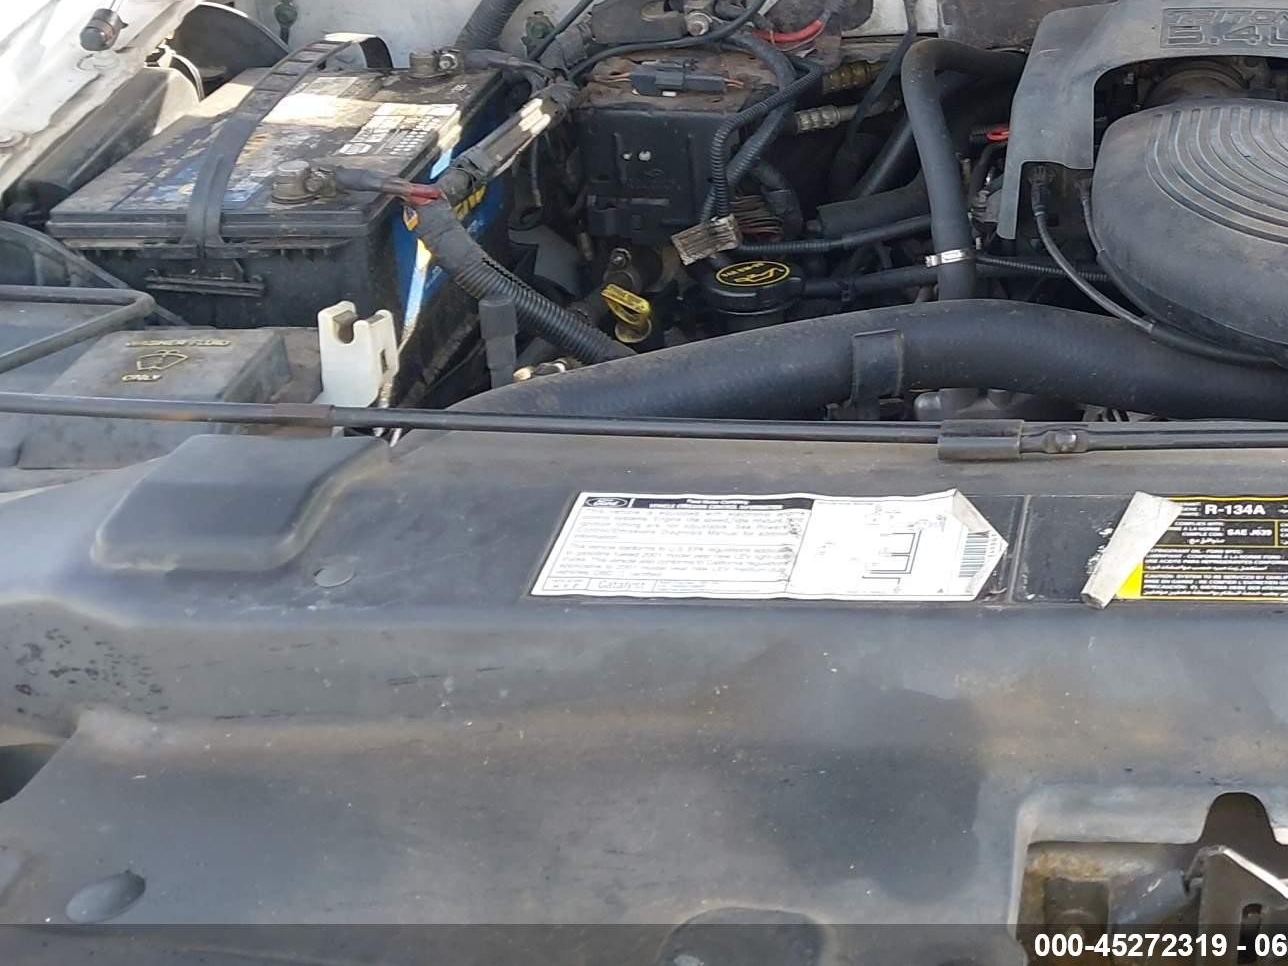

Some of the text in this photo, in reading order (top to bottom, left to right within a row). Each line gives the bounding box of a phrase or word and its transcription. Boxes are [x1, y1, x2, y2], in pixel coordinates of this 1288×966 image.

[189, 338, 232, 346] FLUID
[1205, 504, 1266, 515] R-134A
[598, 580, 647, 589] Catalyst
